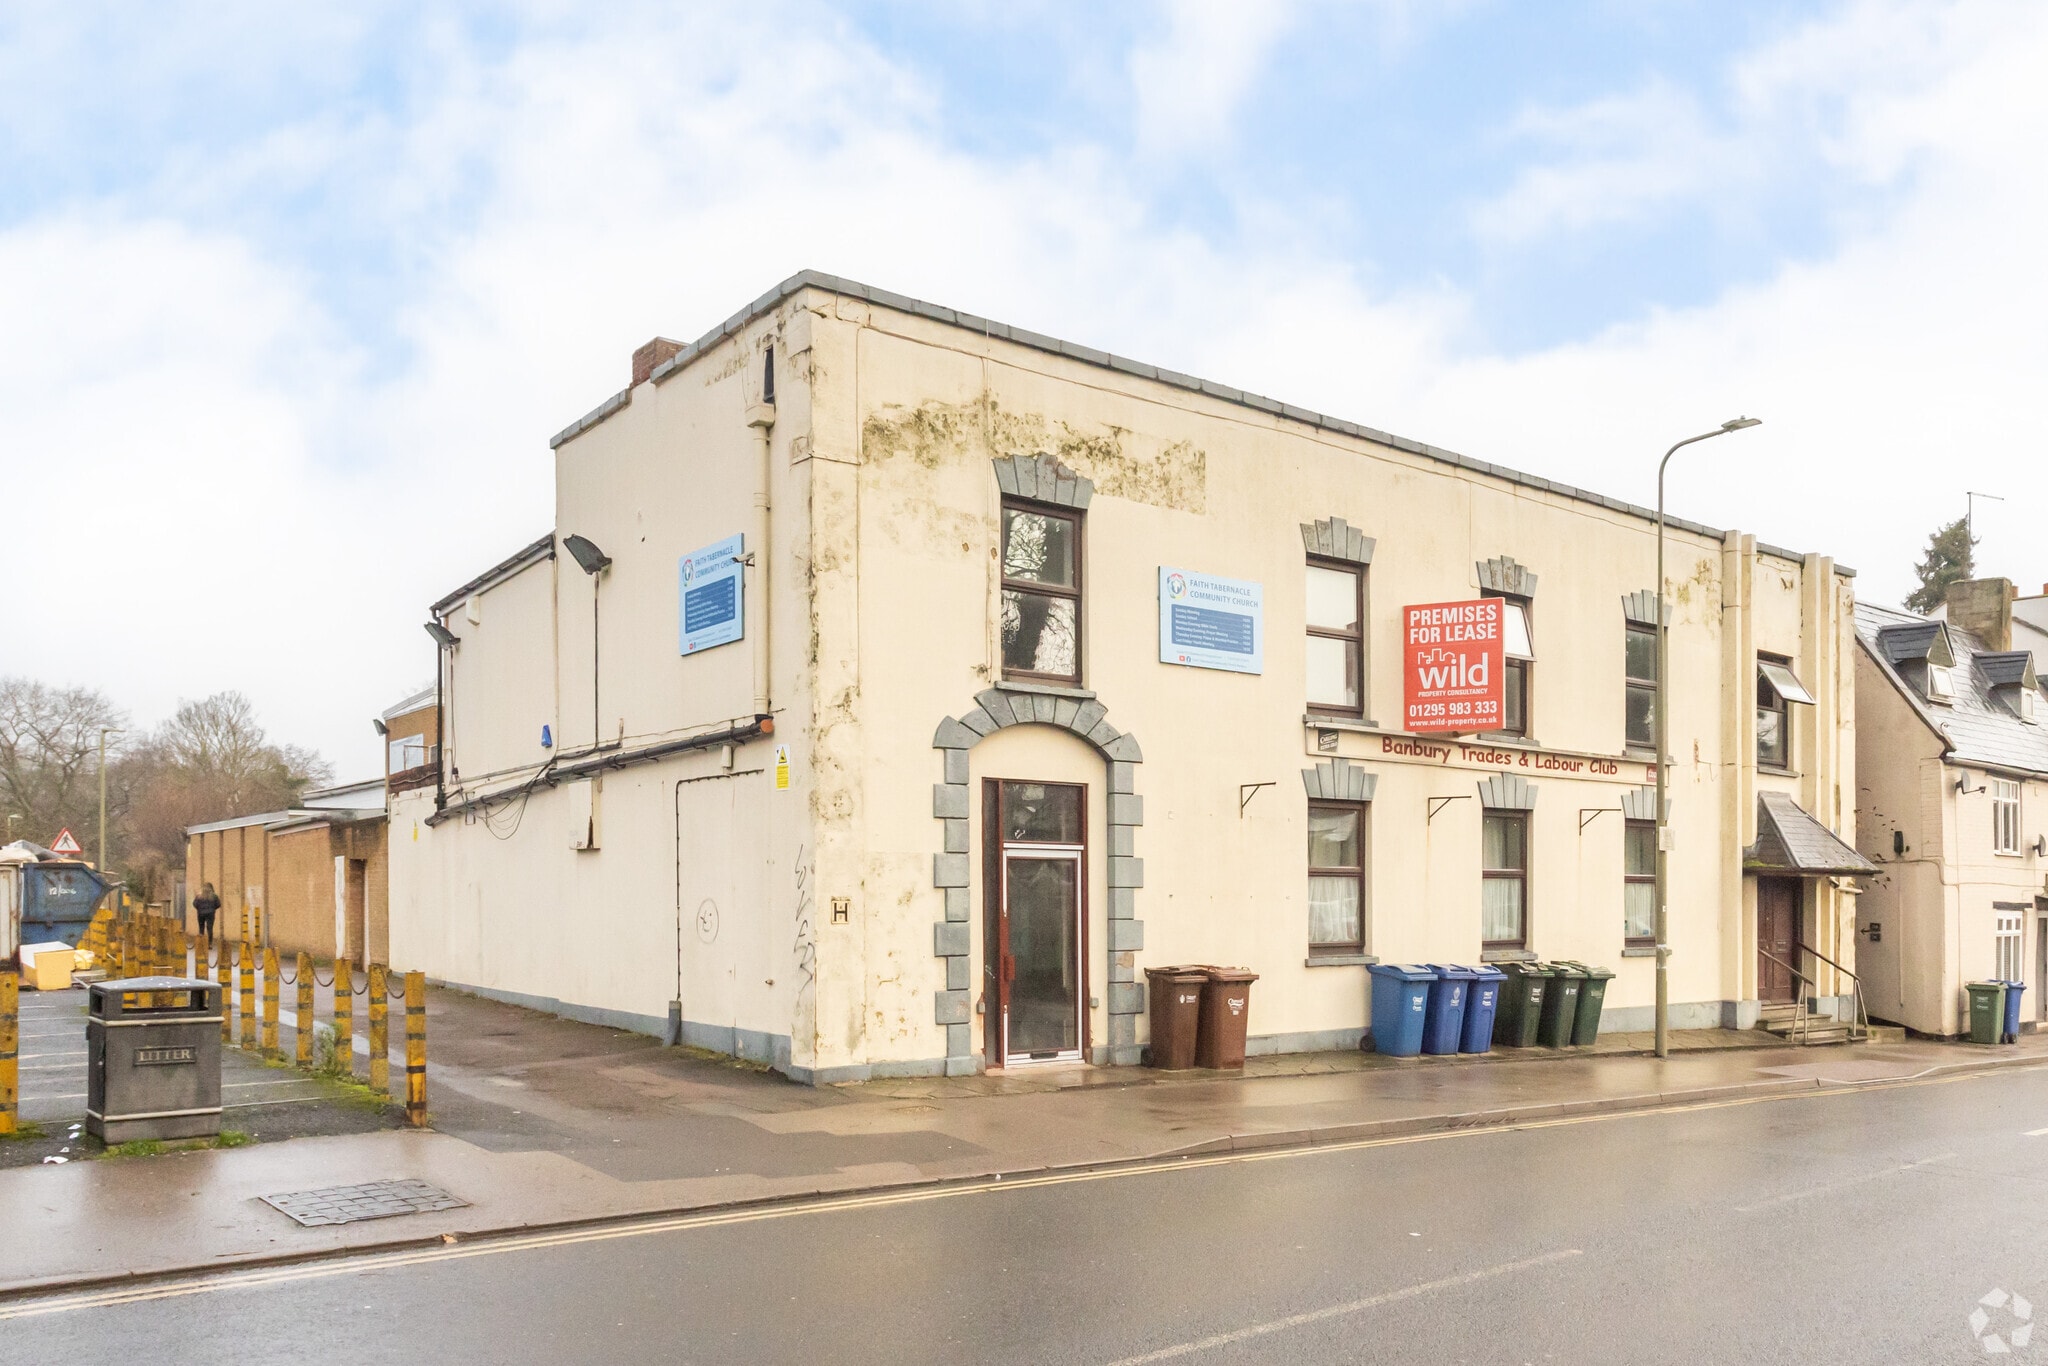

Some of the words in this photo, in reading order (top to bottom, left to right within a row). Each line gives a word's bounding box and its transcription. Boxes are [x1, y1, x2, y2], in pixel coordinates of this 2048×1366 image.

[694, 555, 707, 567] FAITH
[706, 545, 733, 561] TABERNACLE
[694, 563, 720, 579] COMMUNITY
[1189, 579, 1209, 590] FAITH
[1210, 583, 1251, 596] TABERNACLE
[1189, 590, 1231, 603] COMMUNITY
[1232, 597, 1259, 608] CHURCH
[1410, 604, 1497, 627] PREMISES
[1410, 627, 1441, 645] FOR
[1445, 622, 1497, 642] LEASE
[1418, 652, 1489, 689] wild
[1417, 690, 1446, 698] PROPERTY
[1447, 687, 1489, 697] CONSULTANCY
[1409, 703, 1446, 717] 01295
[1449, 701, 1471, 716] 983
[1475, 700, 1497, 714] 333
[1409, 716, 1497, 727] www.wild-property.co.uk
[1382, 735, 1451, 764] Banbury
[1458, 743, 1511, 766] Trades
[1518, 751, 1529, 767] &
[1535, 753, 1584, 773] Labour
[1589, 758, 1618, 775] Club
[833, 902, 848, 922] H
[139, 1047, 191, 1061] LITTER
